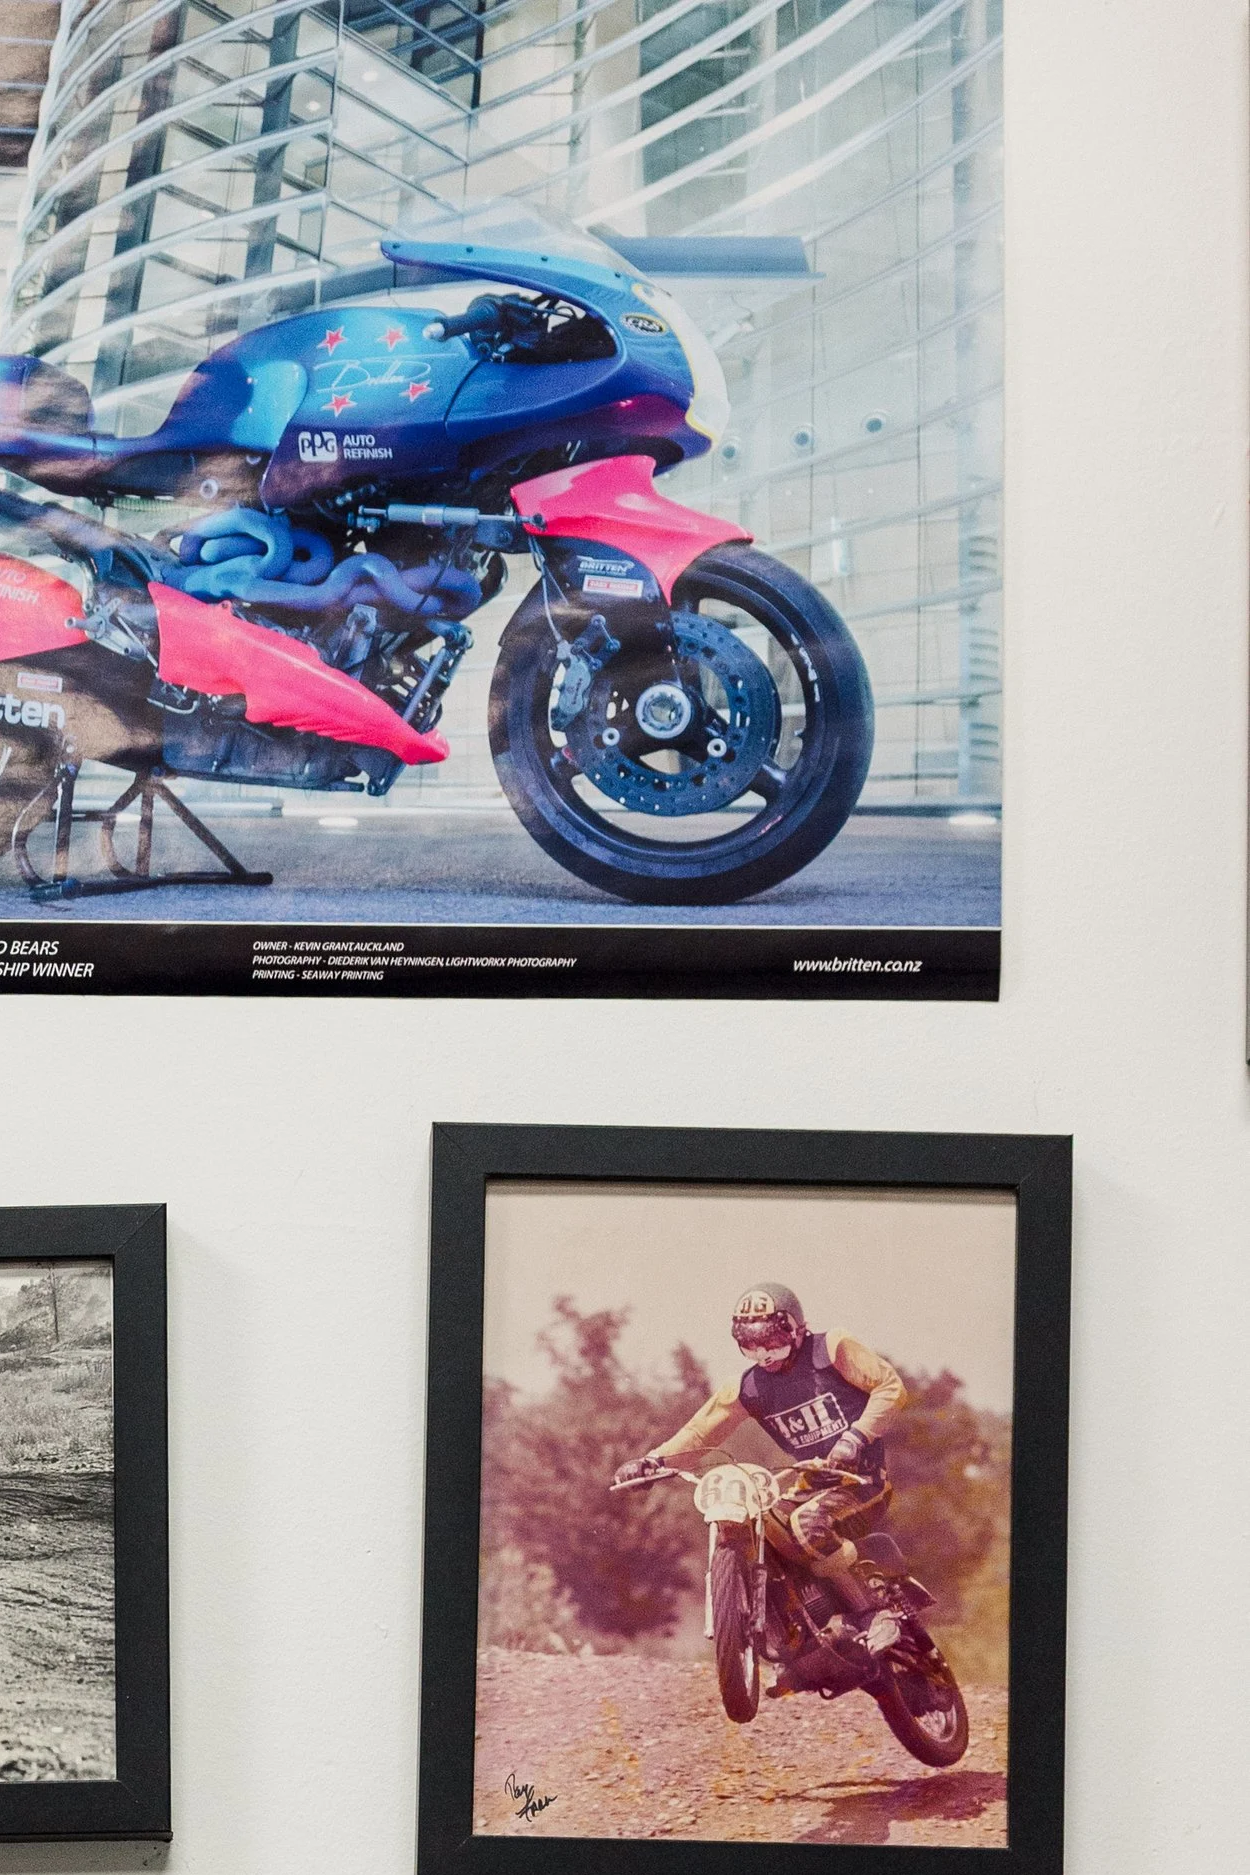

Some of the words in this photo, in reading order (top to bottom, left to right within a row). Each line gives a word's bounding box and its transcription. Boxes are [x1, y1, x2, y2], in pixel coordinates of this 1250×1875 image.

[343, 434, 375, 446] AUTO
[343, 448, 393, 459] REFINISH
[10, 941, 59, 955] BEARS
[253, 941, 288, 951] OWNER
[294, 942, 320, 951] KEVIN
[253, 955, 322, 966] PHOTOGRAPHY
[328, 956, 370, 966] DIEDERIK
[371, 956, 389, 966] VAN
[446, 957, 506, 967] LIGHTWORKX
[507, 958, 577, 968] PHOTOGRAPHY
[793, 957, 923, 973] www.britten.co.nz
[32, 962, 94, 977] WINNER
[253, 970, 295, 980] PRINTING
[301, 971, 341, 980] SEAWAY
[341, 971, 384, 981] PRINTING
